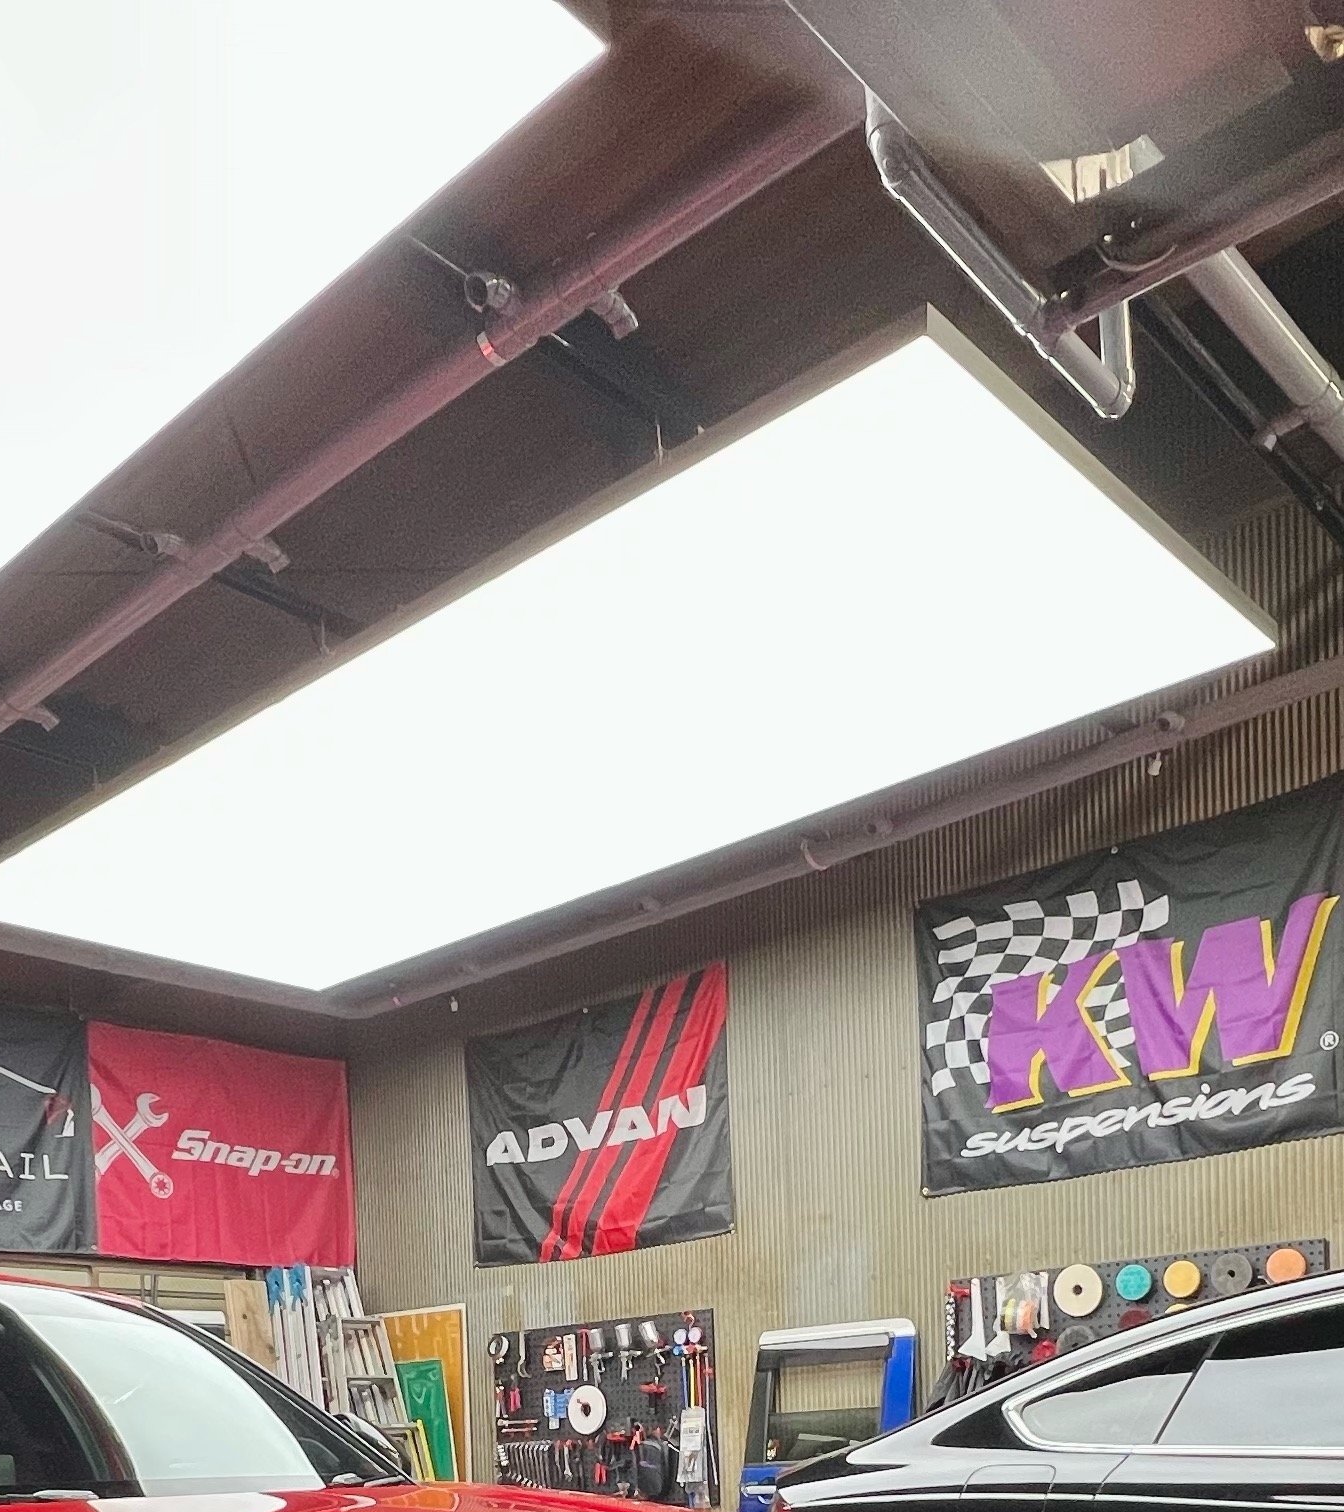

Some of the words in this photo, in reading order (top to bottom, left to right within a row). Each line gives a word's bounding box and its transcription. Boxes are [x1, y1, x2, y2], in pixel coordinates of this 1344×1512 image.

[984, 892, 1340, 1114] KW
[171, 1129, 336, 1177] Snap-on
[486, 1085, 707, 1166] ADVAN
